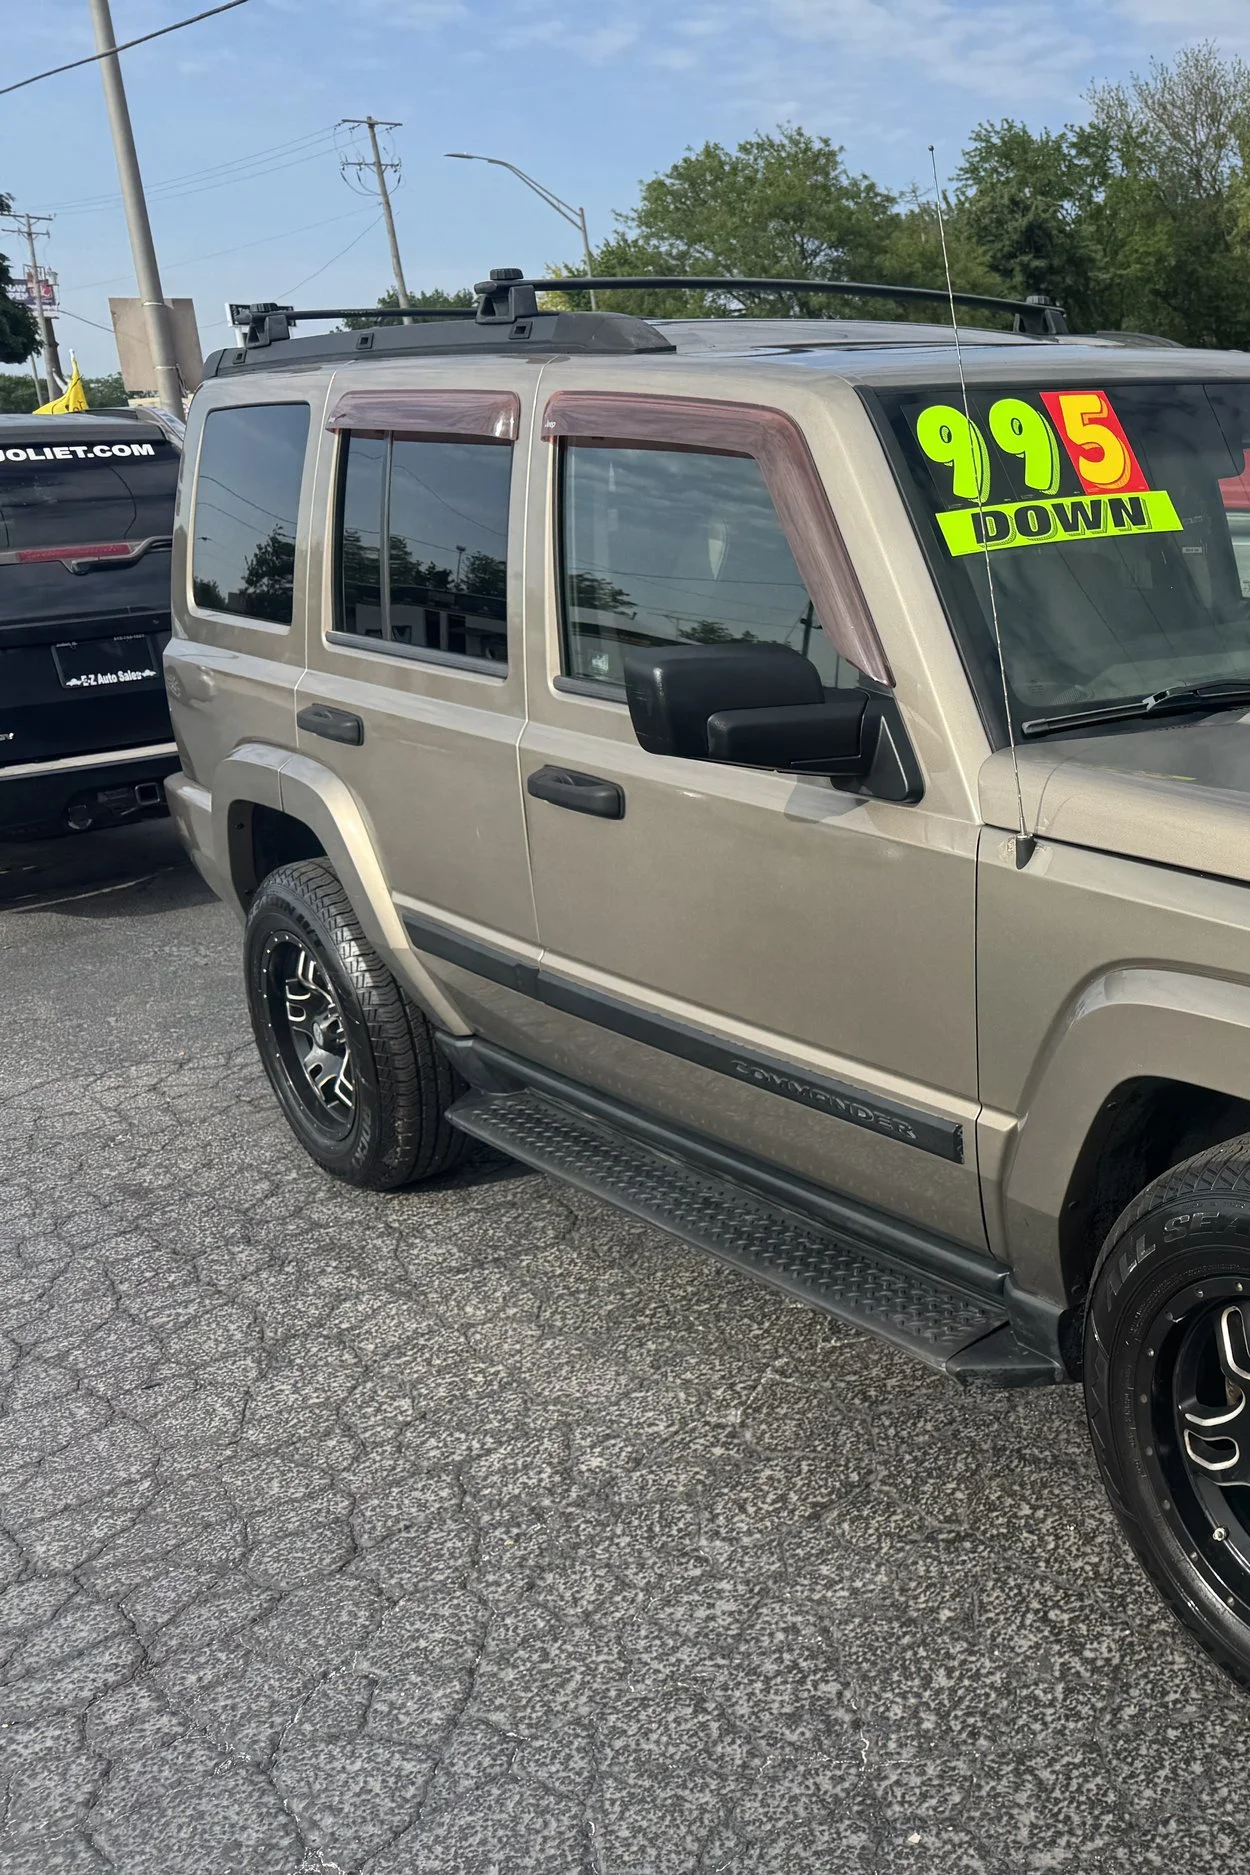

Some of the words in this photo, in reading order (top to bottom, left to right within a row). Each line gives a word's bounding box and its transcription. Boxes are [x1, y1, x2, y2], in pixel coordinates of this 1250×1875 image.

[916, 393, 1131, 503] 995
[970, 496, 1153, 549] DOWN
[98, 672, 118, 685] Auto
[118, 669, 143, 682] Sales
[729, 1058, 918, 1140] COMMANDER
